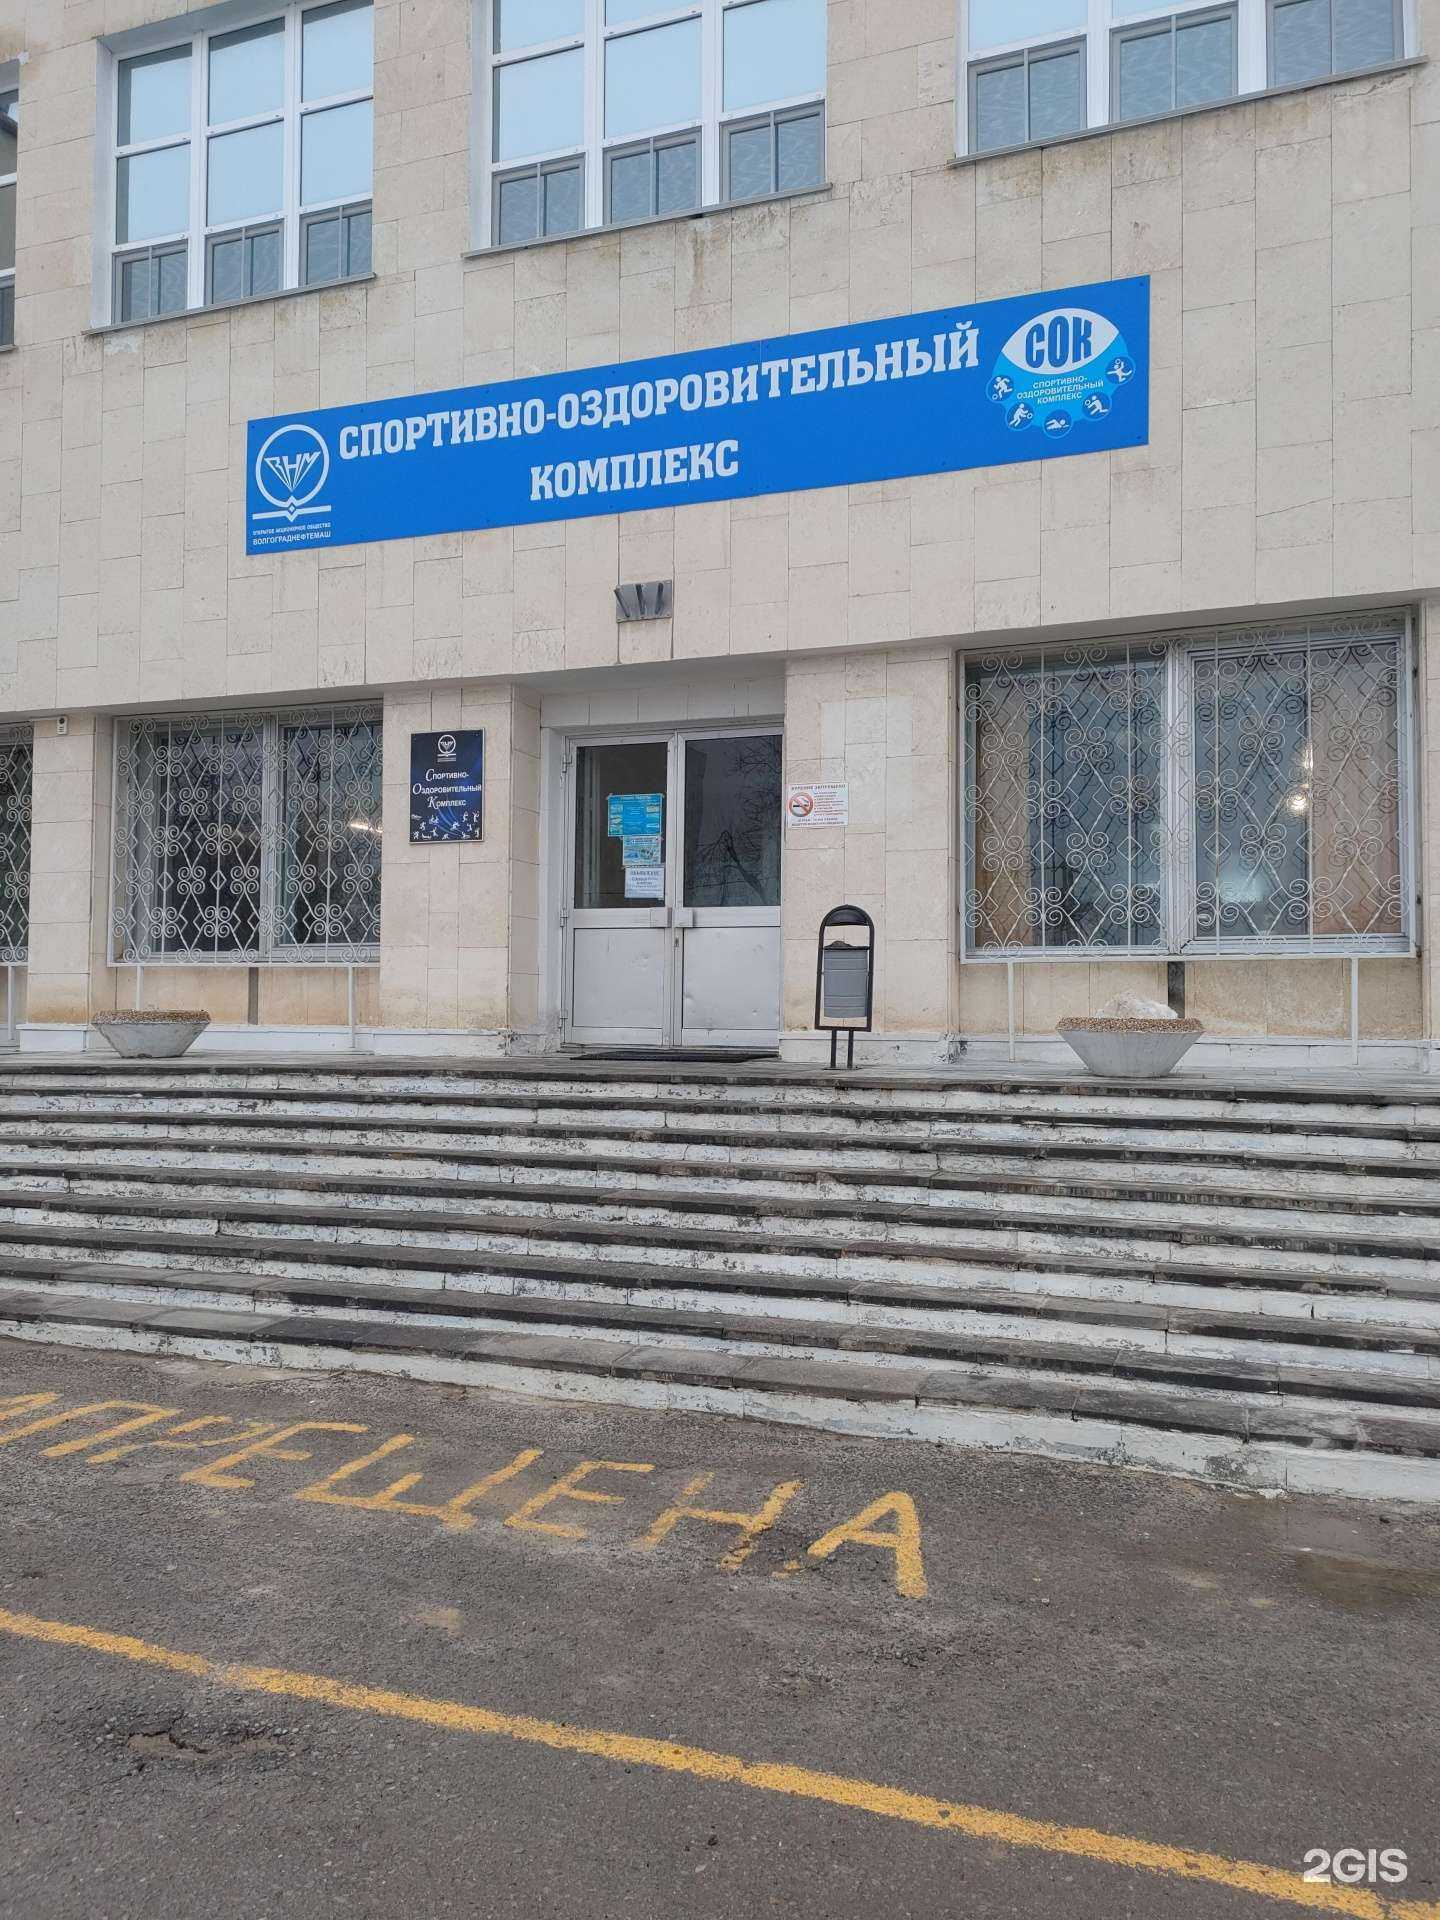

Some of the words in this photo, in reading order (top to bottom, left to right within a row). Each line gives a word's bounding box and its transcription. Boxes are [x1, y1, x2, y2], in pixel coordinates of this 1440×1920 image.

[1025, 314, 1093, 369] СОК
[338, 320, 980, 461] СПОРТИВНО-ОЗДОРОВИТЕЛЬНЫЙ
[1016, 380, 1104, 400] ОЗДОРОВИТЕЛЬНЫЙ
[1032, 375, 1088, 389] СПОРТИВНО-
[1037, 391, 1083, 405] КОМПЛЕКС
[530, 439, 739, 501] КОМПЛЕКС
[252, 531, 332, 546] ВОЛГОГРАДНЕФТЕМАШ
